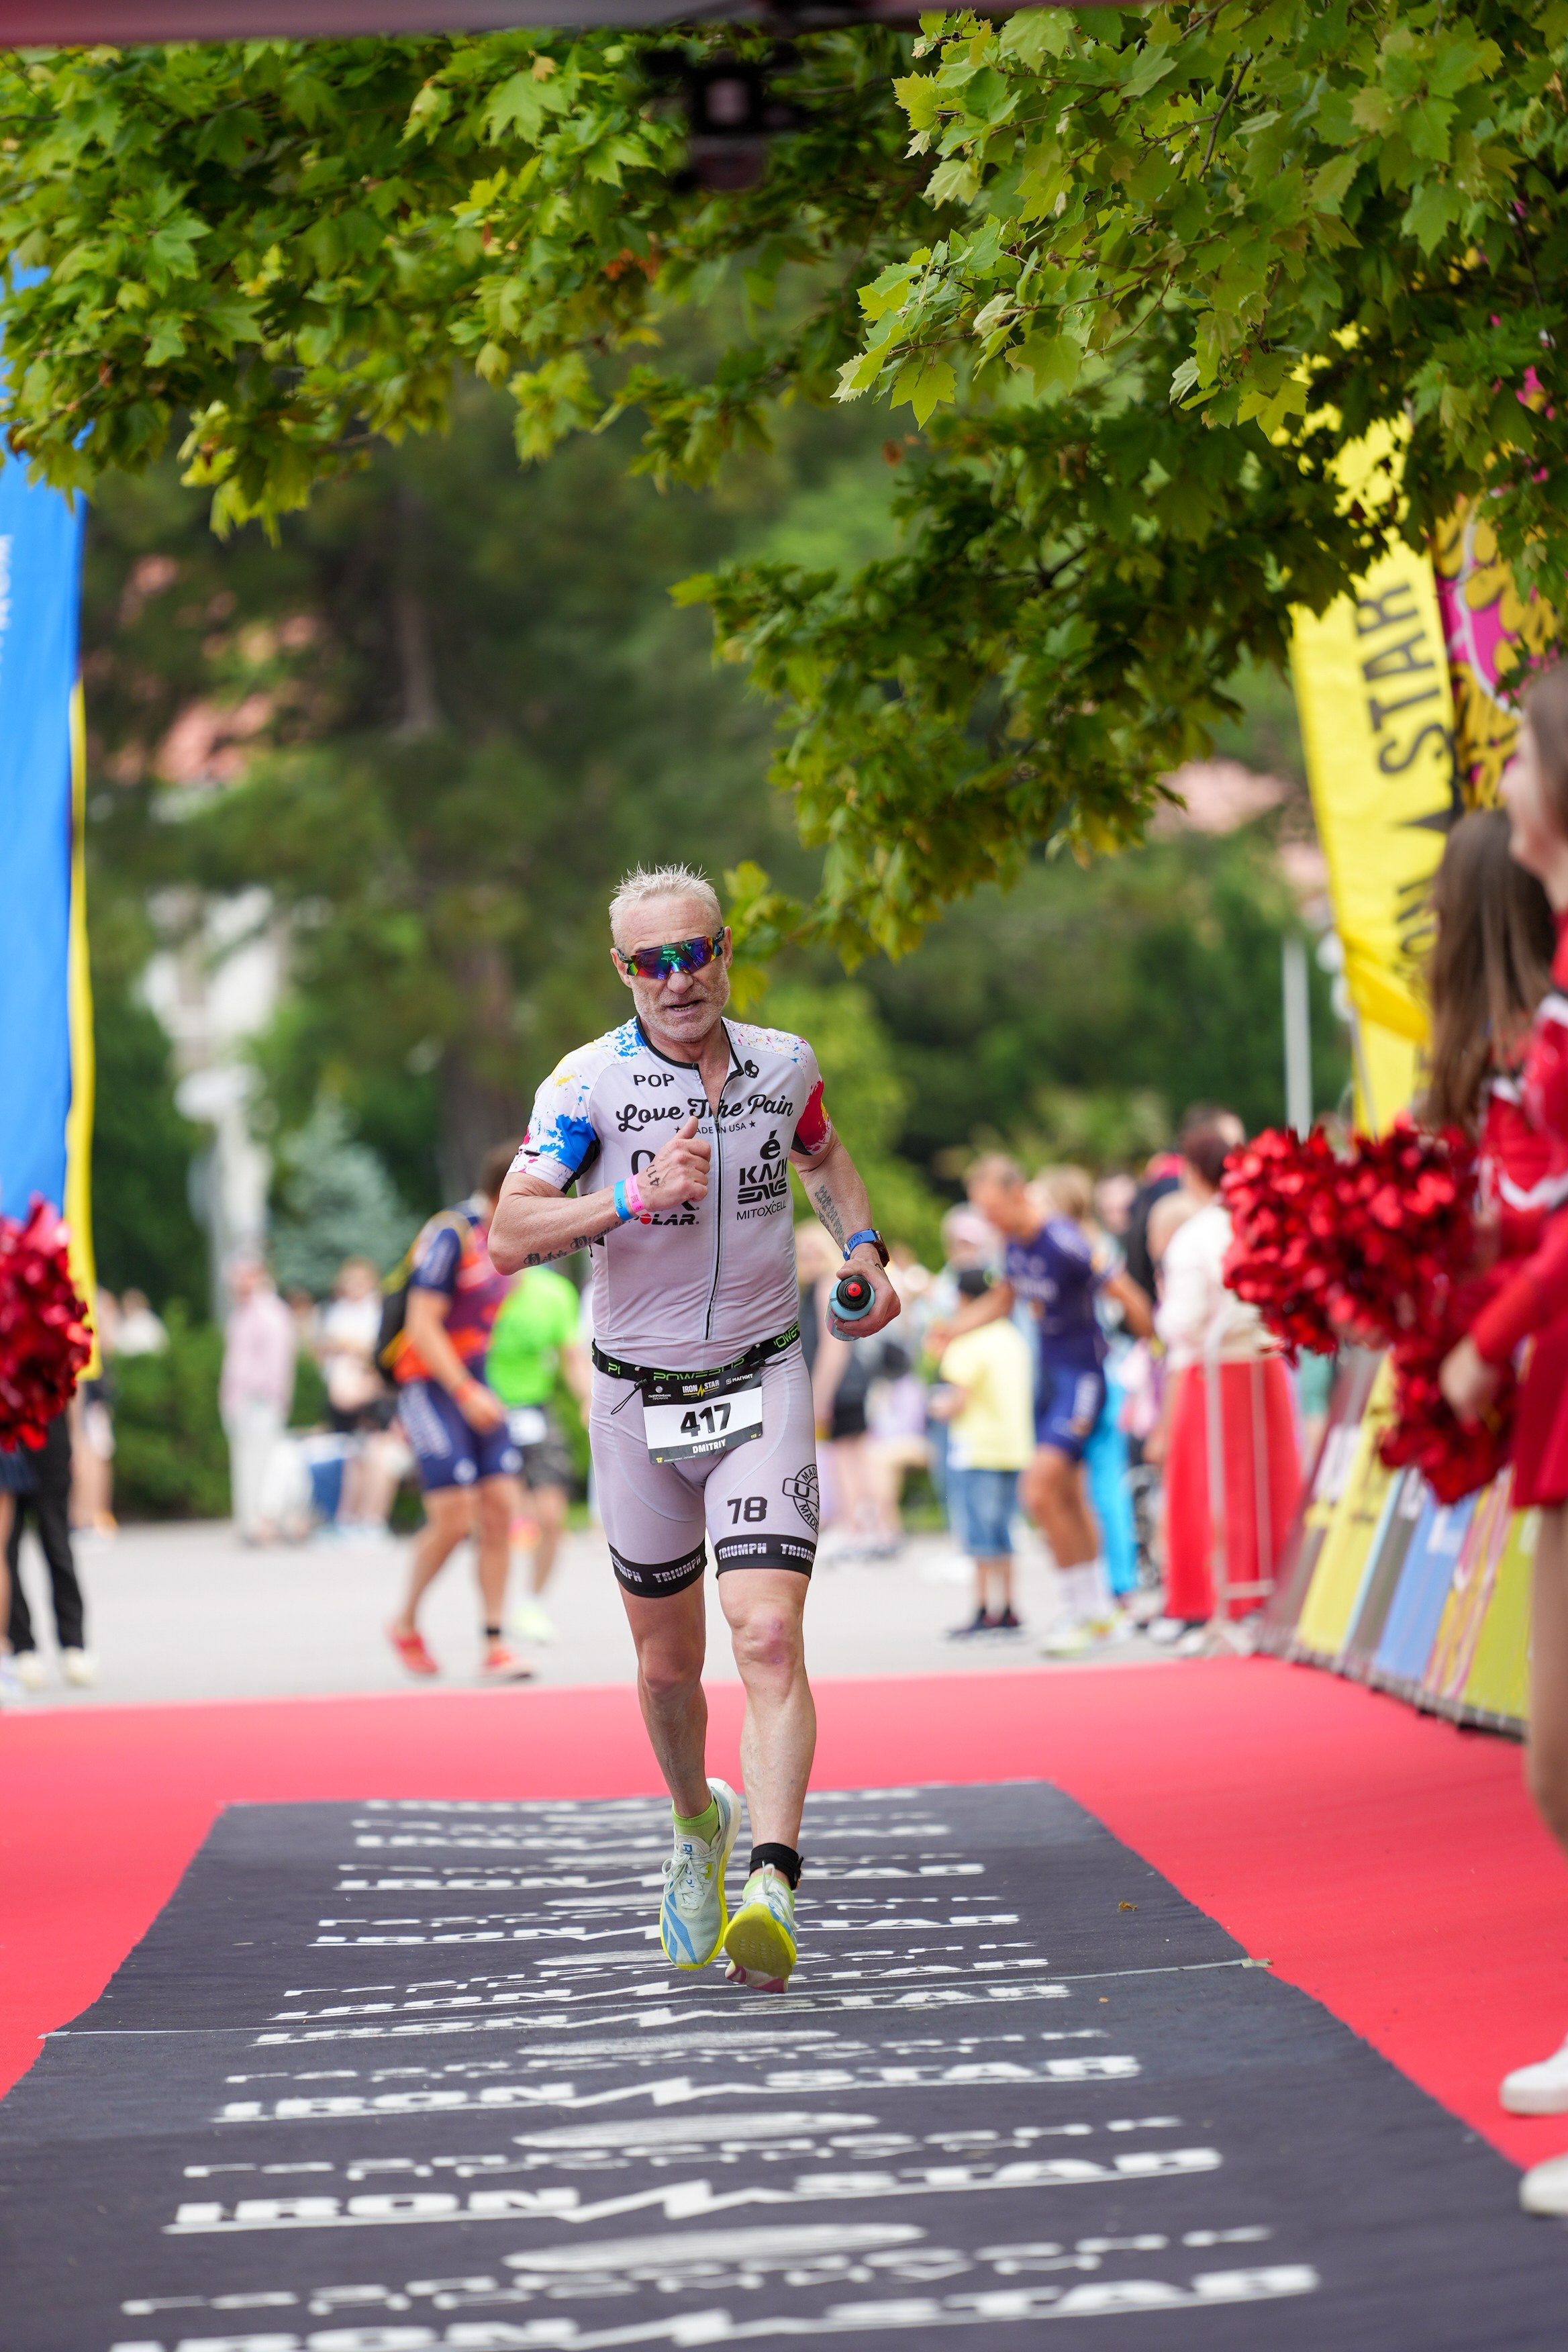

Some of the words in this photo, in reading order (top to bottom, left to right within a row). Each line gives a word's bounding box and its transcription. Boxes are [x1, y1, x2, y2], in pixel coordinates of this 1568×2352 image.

[1355, 579, 1445, 776] STAR
[633, 1073, 675, 1087] POP
[616, 1103, 684, 1133] Love
[747, 1094, 793, 1118] Pain
[729, 1122, 746, 1132] USA
[682, 1384, 698, 1393] IRON
[703, 1380, 720, 1389] STAR
[732, 1374, 753, 1383] МАГНИТ
[680, 1402, 732, 1437] 417
[692, 1438, 726, 1454] DMITRIY
[727, 1496, 768, 1524] 78
[718, 1542, 767, 1561] TRIUMPH
[652, 1555, 701, 1583] TRIUMPH
[340, 1876, 588, 1889] IRON
[315, 1926, 586, 1943] IRON
[803, 1914, 1020, 1928] TAR
[273, 1989, 571, 2018] IRON
[787, 1959, 1049, 1981] TAR
[255, 2015, 568, 2043] IRON
[738, 1985, 1071, 2011] STAR
[223, 2082, 575, 2117] IRON
[765, 2055, 1141, 2088] STAR
[175, 2186, 580, 2224] IRON
[793, 2147, 1222, 2194] STAR
[823, 2263, 1321, 2324] STAR
